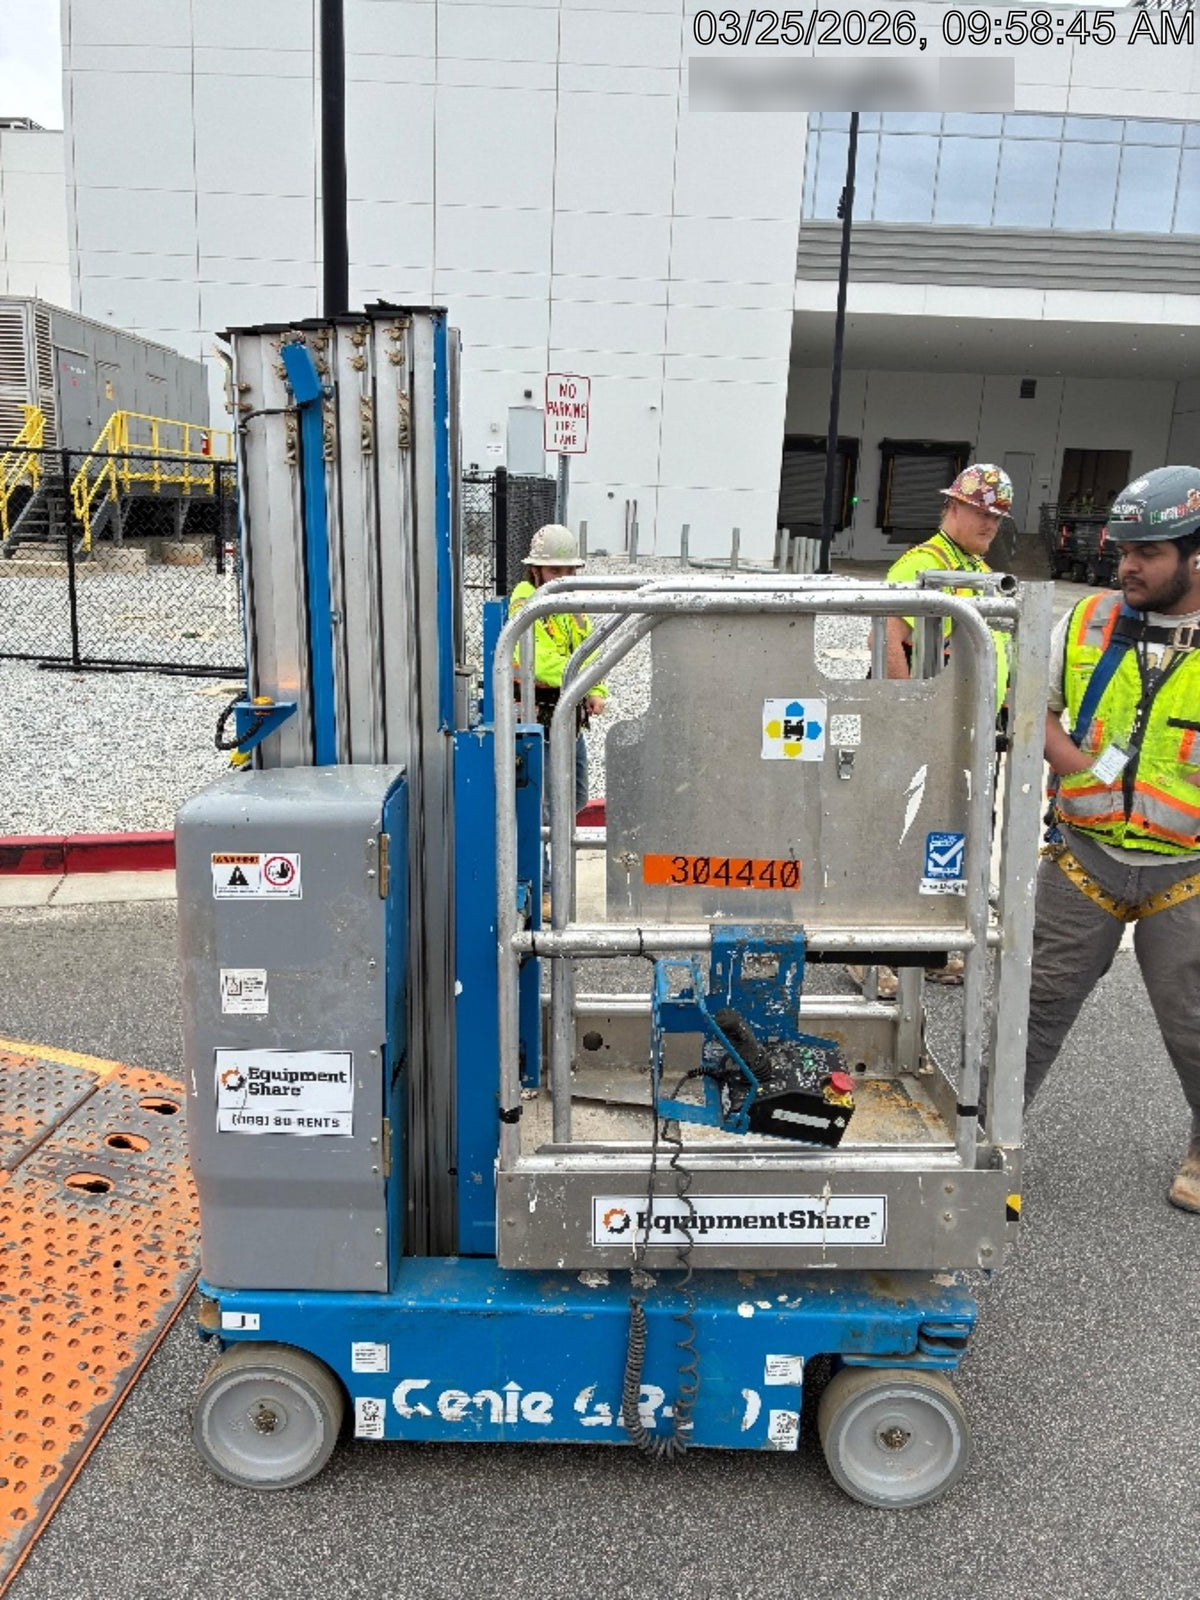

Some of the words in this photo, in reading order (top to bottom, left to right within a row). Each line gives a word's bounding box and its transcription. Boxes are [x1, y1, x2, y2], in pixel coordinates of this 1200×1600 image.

[559, 383, 577, 399] NO
[547, 401, 588, 419] PARKING
[671, 856, 800, 888] 304440
[248, 1067, 347, 1083] Equipment
[248, 1082, 302, 1096] Share
[636, 1210, 870, 1234] EquipmentShare
[392, 1379, 554, 1424] Genie
